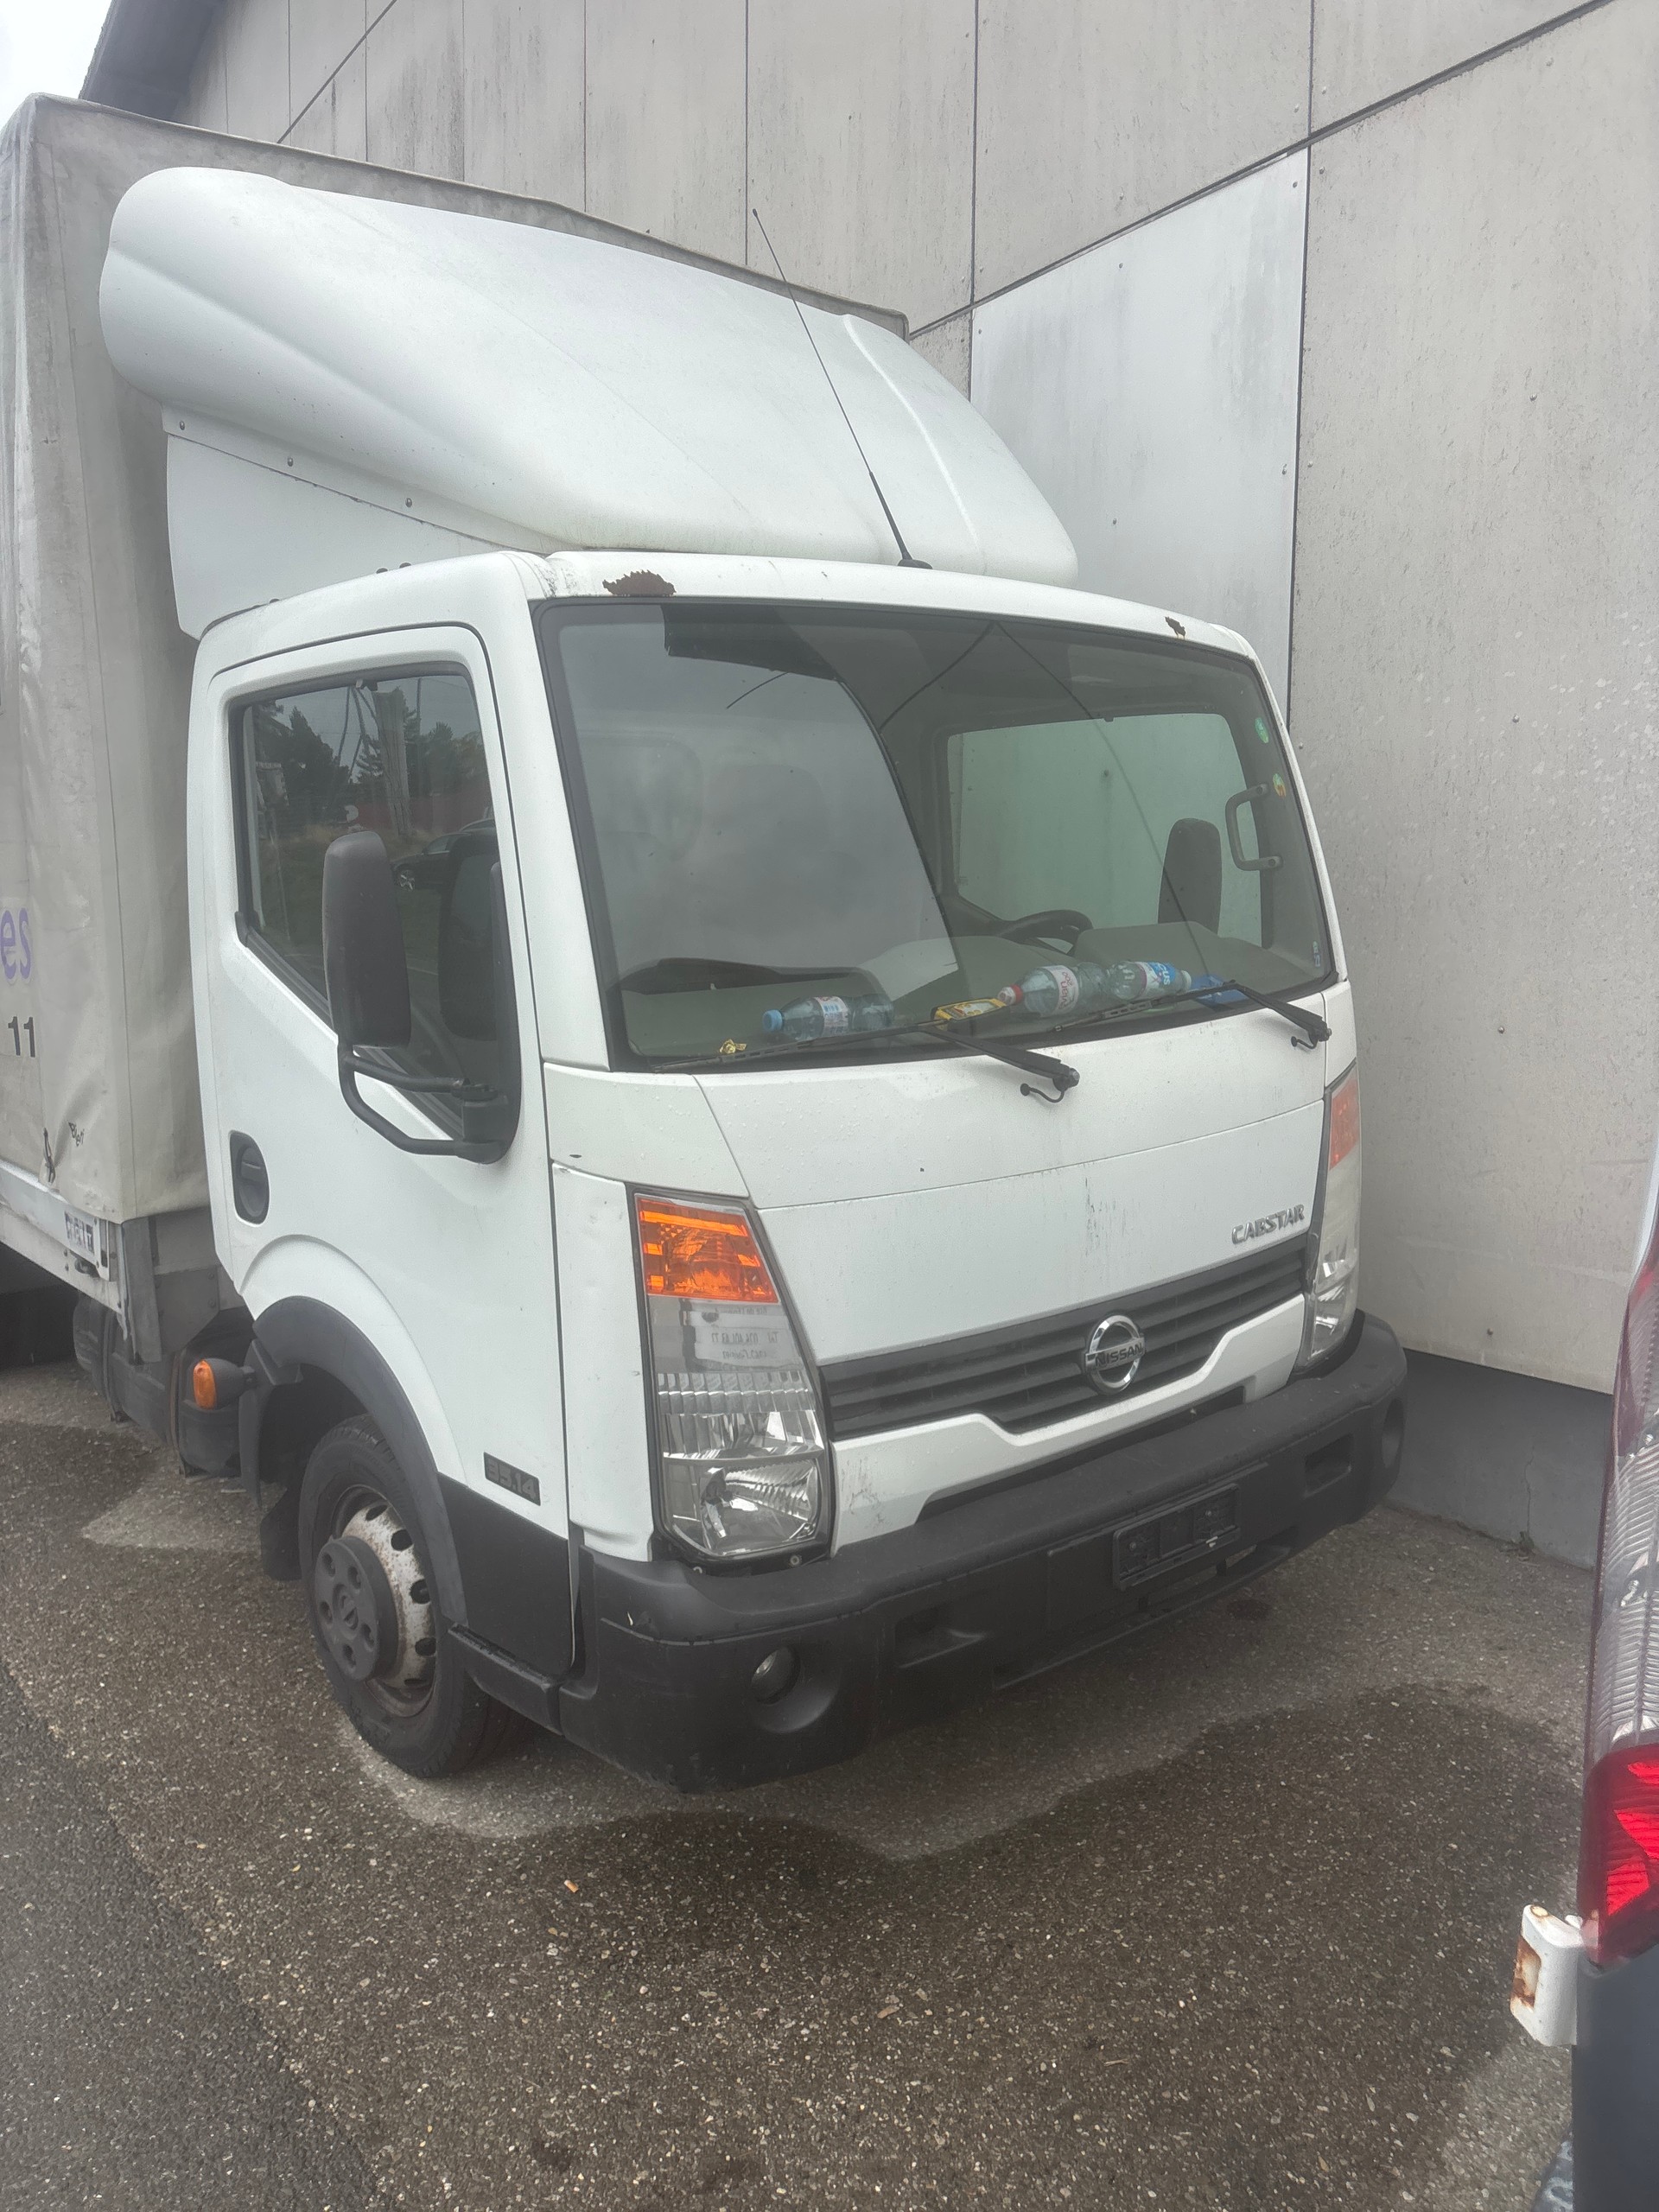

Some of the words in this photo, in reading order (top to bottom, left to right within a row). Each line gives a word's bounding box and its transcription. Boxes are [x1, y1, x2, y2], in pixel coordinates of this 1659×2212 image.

[8, 1016, 35, 1058] 11
[1231, 1204, 1305, 1244] CABSTAR
[1096, 1343, 1143, 1367] NISSAN
[487, 1457, 537, 1500] 35.14
